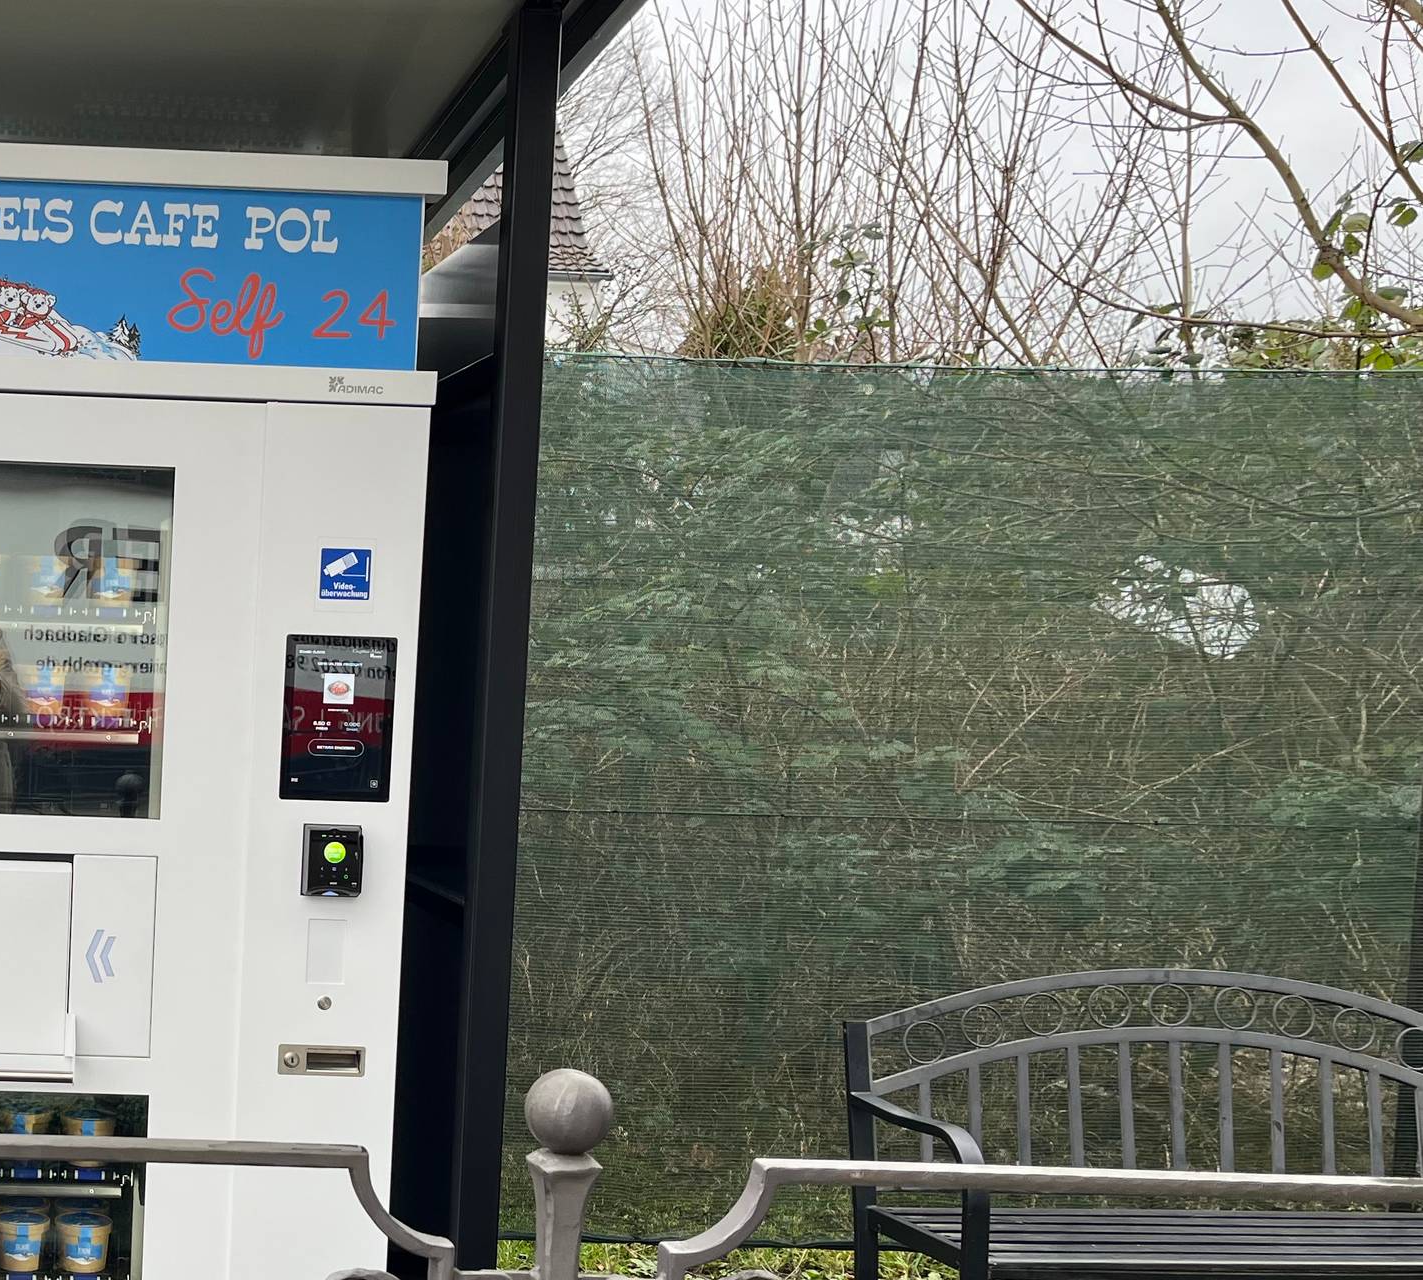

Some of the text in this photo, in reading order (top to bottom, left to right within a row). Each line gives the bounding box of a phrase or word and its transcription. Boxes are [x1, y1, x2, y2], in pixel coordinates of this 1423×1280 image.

[89, 200, 220, 249] CAFE
[244, 206, 338, 253] POL
[167, 267, 397, 360] Self 24
[337, 385, 384, 395] ADIMAC
[333, 581, 357, 590] Video-
[320, 588, 368, 600] überwachung
